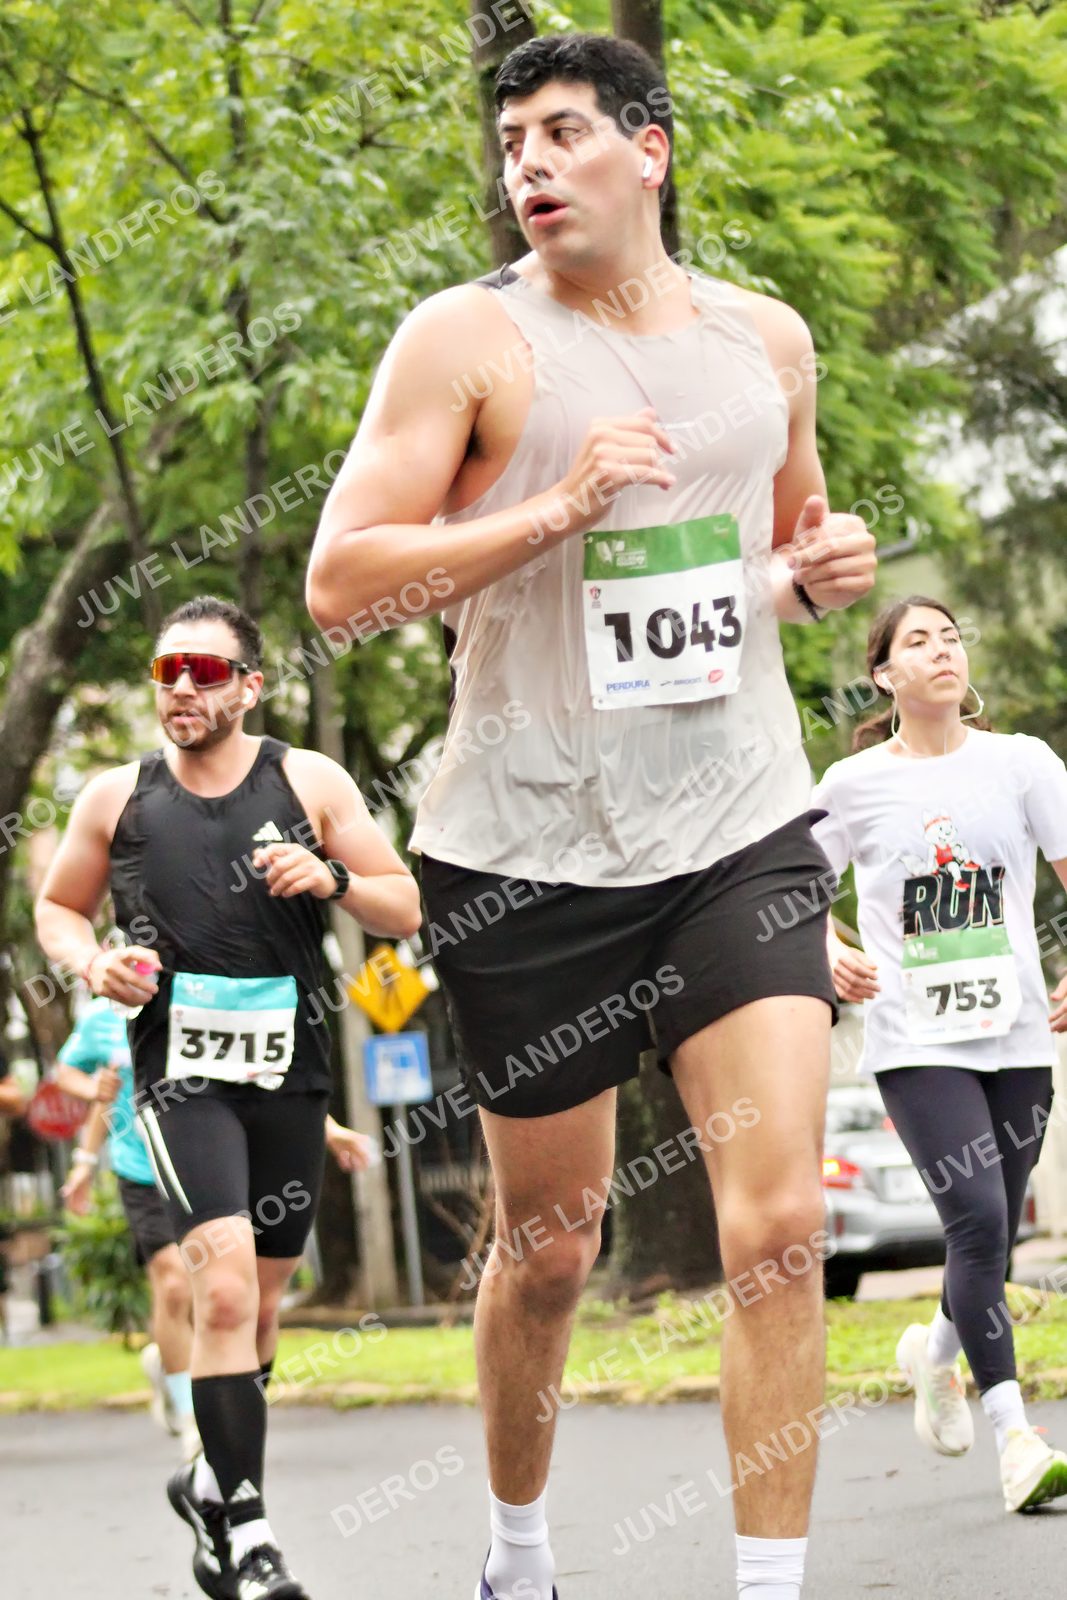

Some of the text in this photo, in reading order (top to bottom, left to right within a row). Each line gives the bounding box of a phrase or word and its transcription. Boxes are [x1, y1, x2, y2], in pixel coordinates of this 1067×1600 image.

[604, 596, 742, 662] 1043
[903, 866, 1005, 937] RUN
[926, 978, 1001, 1015] 753
[180, 1027, 287, 1063] 3715
